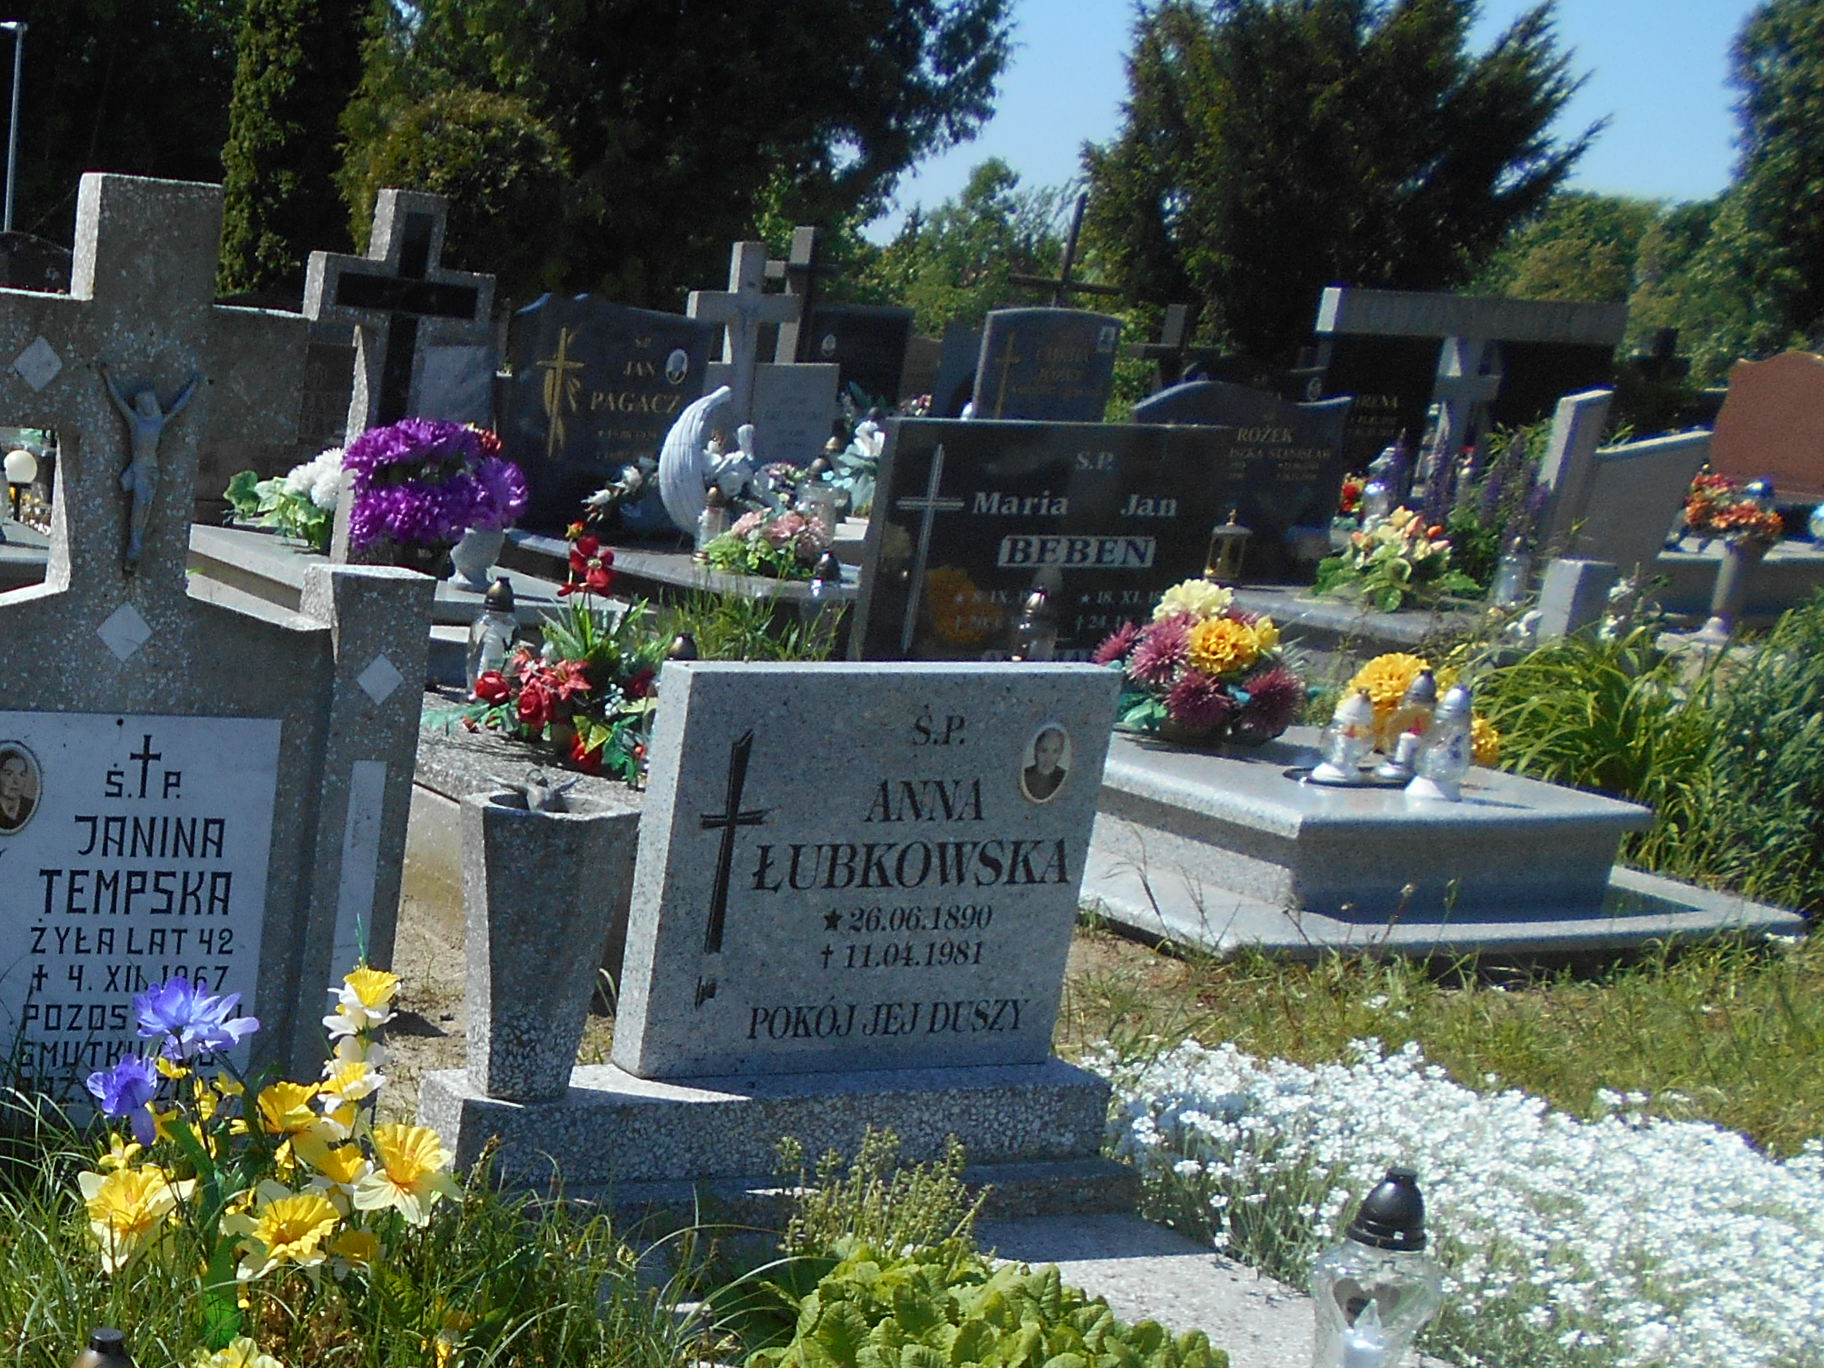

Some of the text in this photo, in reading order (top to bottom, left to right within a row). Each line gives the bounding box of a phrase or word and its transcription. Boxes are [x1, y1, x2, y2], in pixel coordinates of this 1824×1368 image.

[623, 360, 656, 377] JAN
[590, 391, 683, 415] PAGACZ
[972, 491, 1179, 517] Maria Jan
[865, 778, 984, 822] ANNA
[75, 815, 226, 859] JANINA
[750, 839, 1070, 893] ŁUBKOWSKA
[39, 868, 233, 916] TEMPSKA
[31, 918, 234, 955] ŻYŁA LAT 42
[849, 905, 993, 934] 26.06.1890
[845, 942, 984, 969] 11.04.1981
[748, 995, 1032, 1040] POKÓJ JEJ DUSZY
